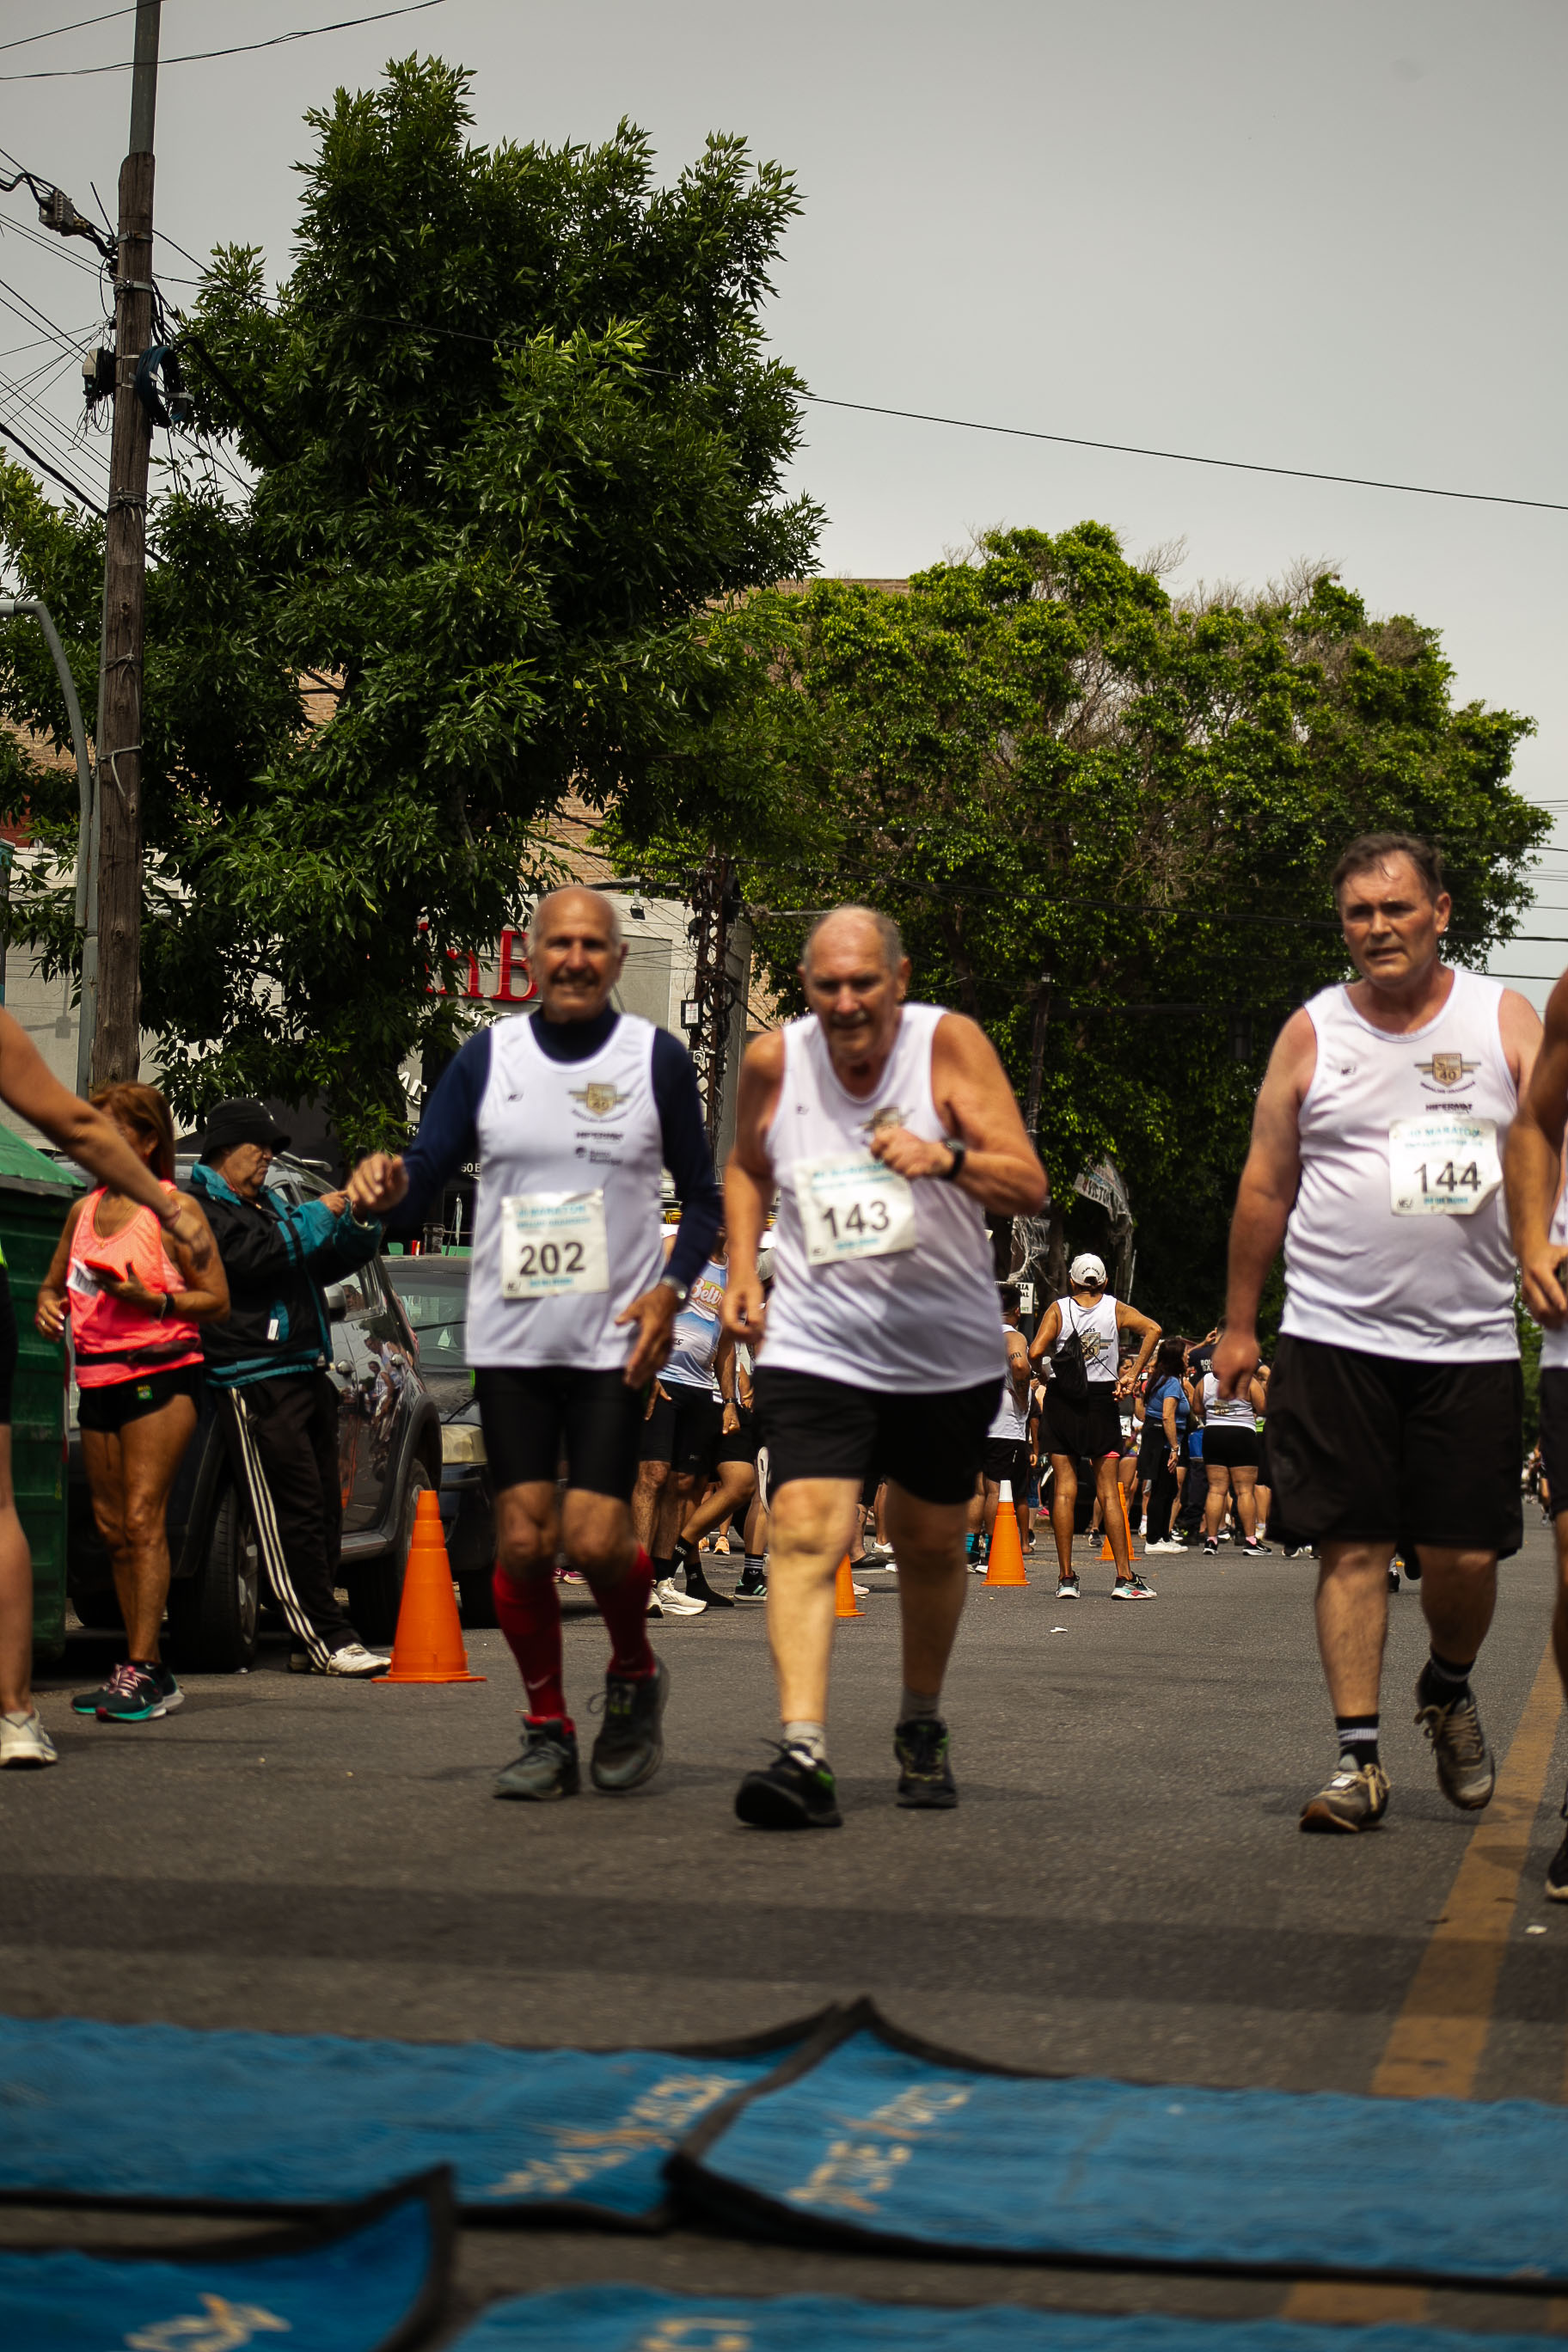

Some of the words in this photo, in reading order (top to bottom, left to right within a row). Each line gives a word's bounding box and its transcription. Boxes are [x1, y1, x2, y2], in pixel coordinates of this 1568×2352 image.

[1413, 1161, 1482, 1194] 144
[822, 1200, 890, 1239] 143
[519, 1241, 585, 1276] 202
